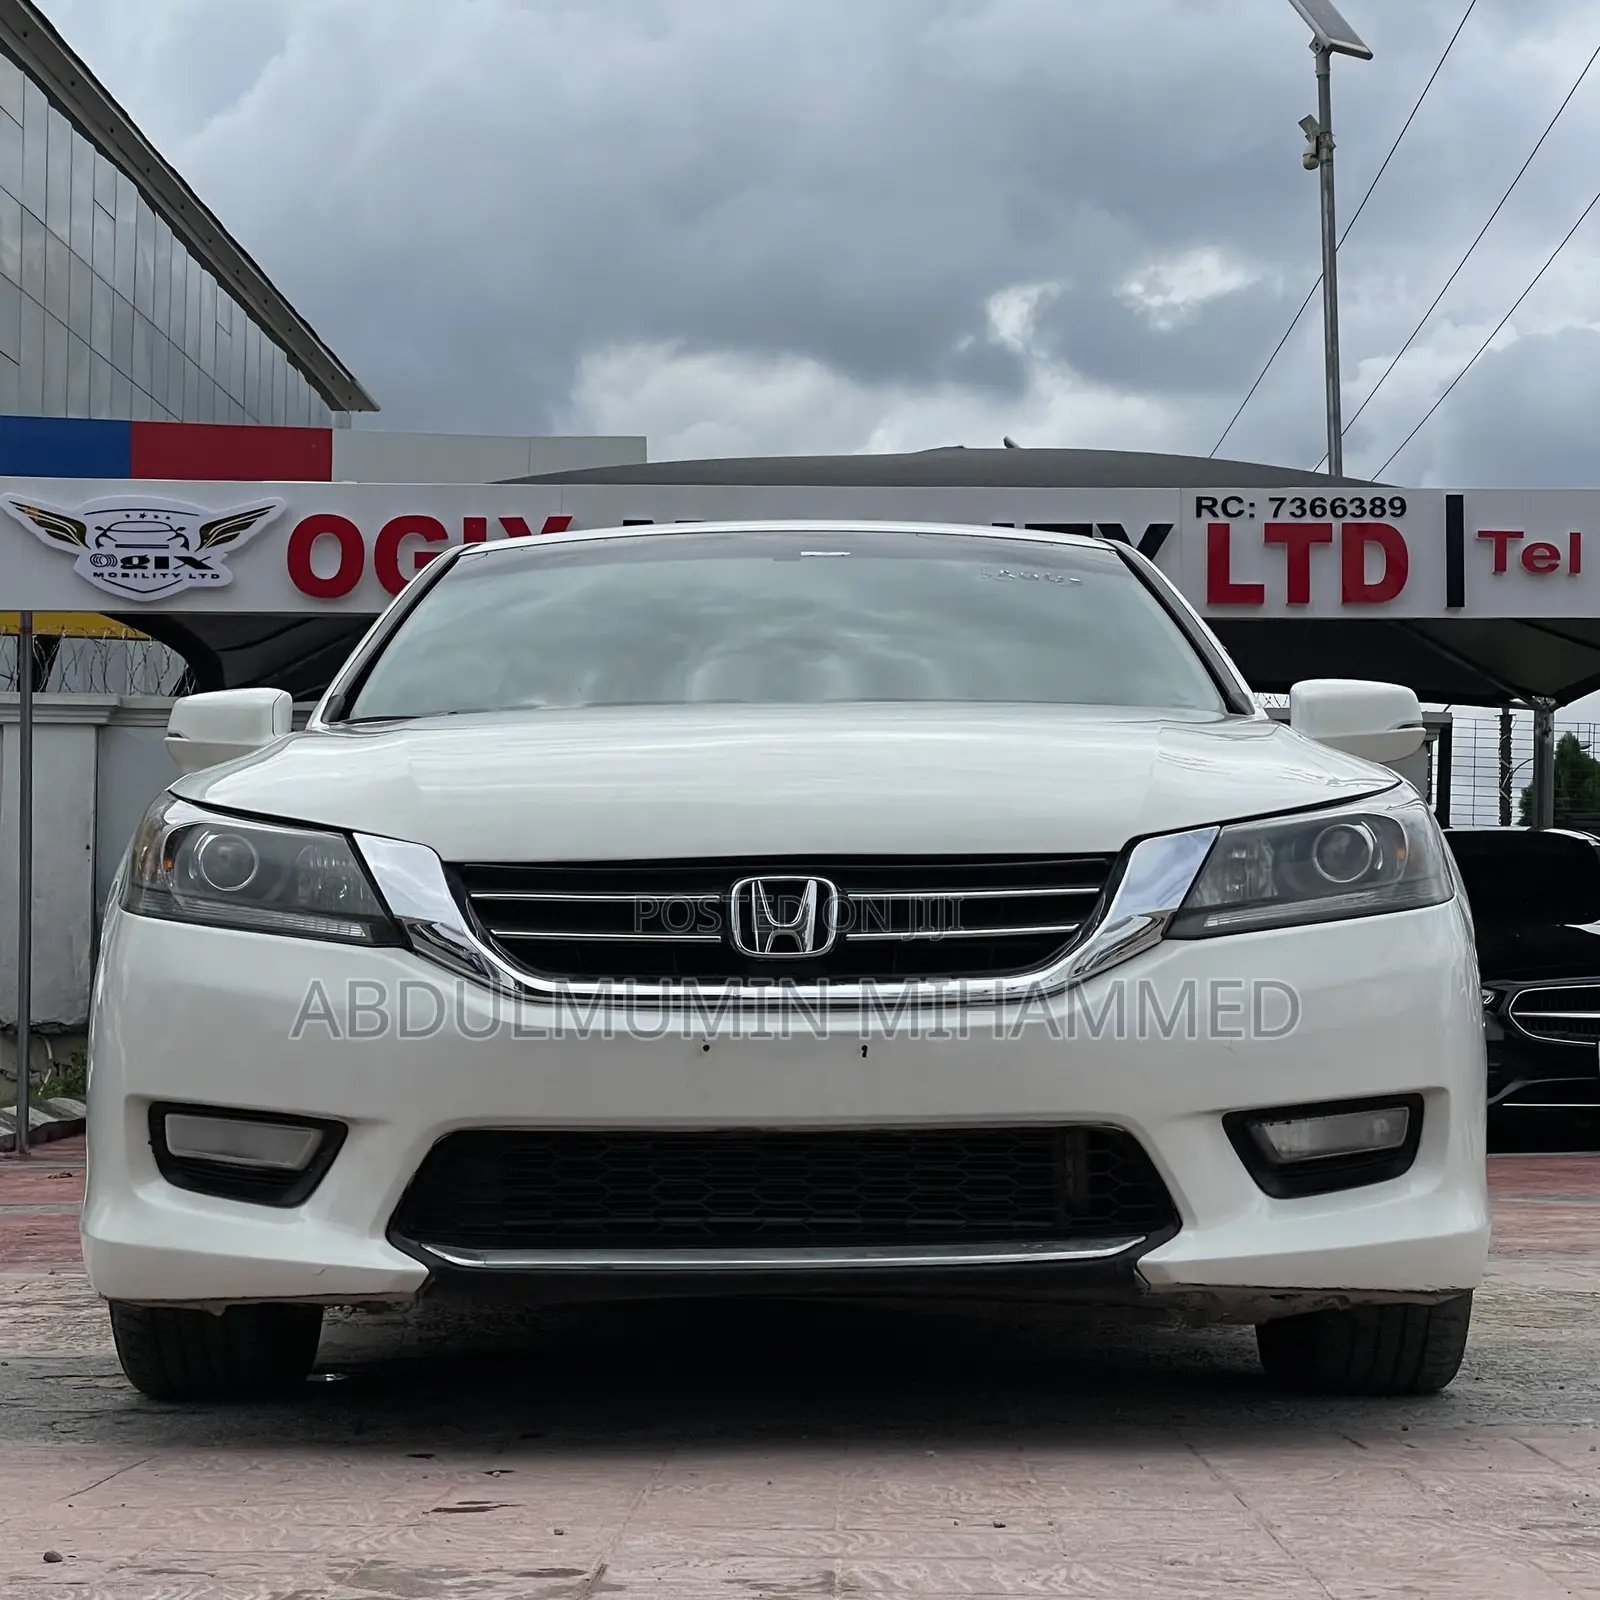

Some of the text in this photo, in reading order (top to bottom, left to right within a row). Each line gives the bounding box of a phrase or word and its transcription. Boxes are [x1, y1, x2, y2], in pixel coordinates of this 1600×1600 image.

[1195, 496, 1407, 519] RC: 7366389
[93, 571, 181, 579] MOBILITY
[1206, 522, 1409, 605] LTD
[1476, 530, 1581, 574] Tel
